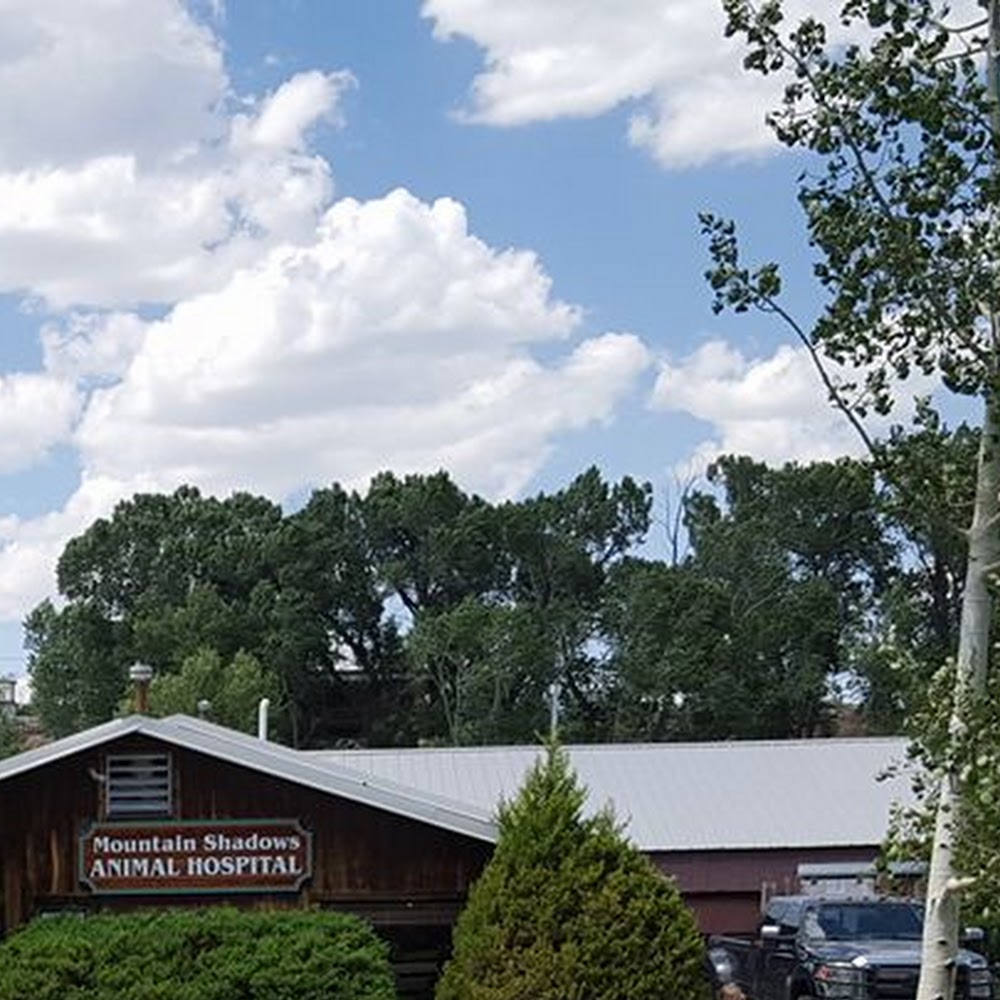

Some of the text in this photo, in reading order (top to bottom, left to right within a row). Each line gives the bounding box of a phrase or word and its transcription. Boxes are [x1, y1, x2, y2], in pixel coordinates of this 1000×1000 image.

[93, 834, 300, 853] Mountain Shadows
[90, 856, 302, 878] ANIMAL HOSPITAL
